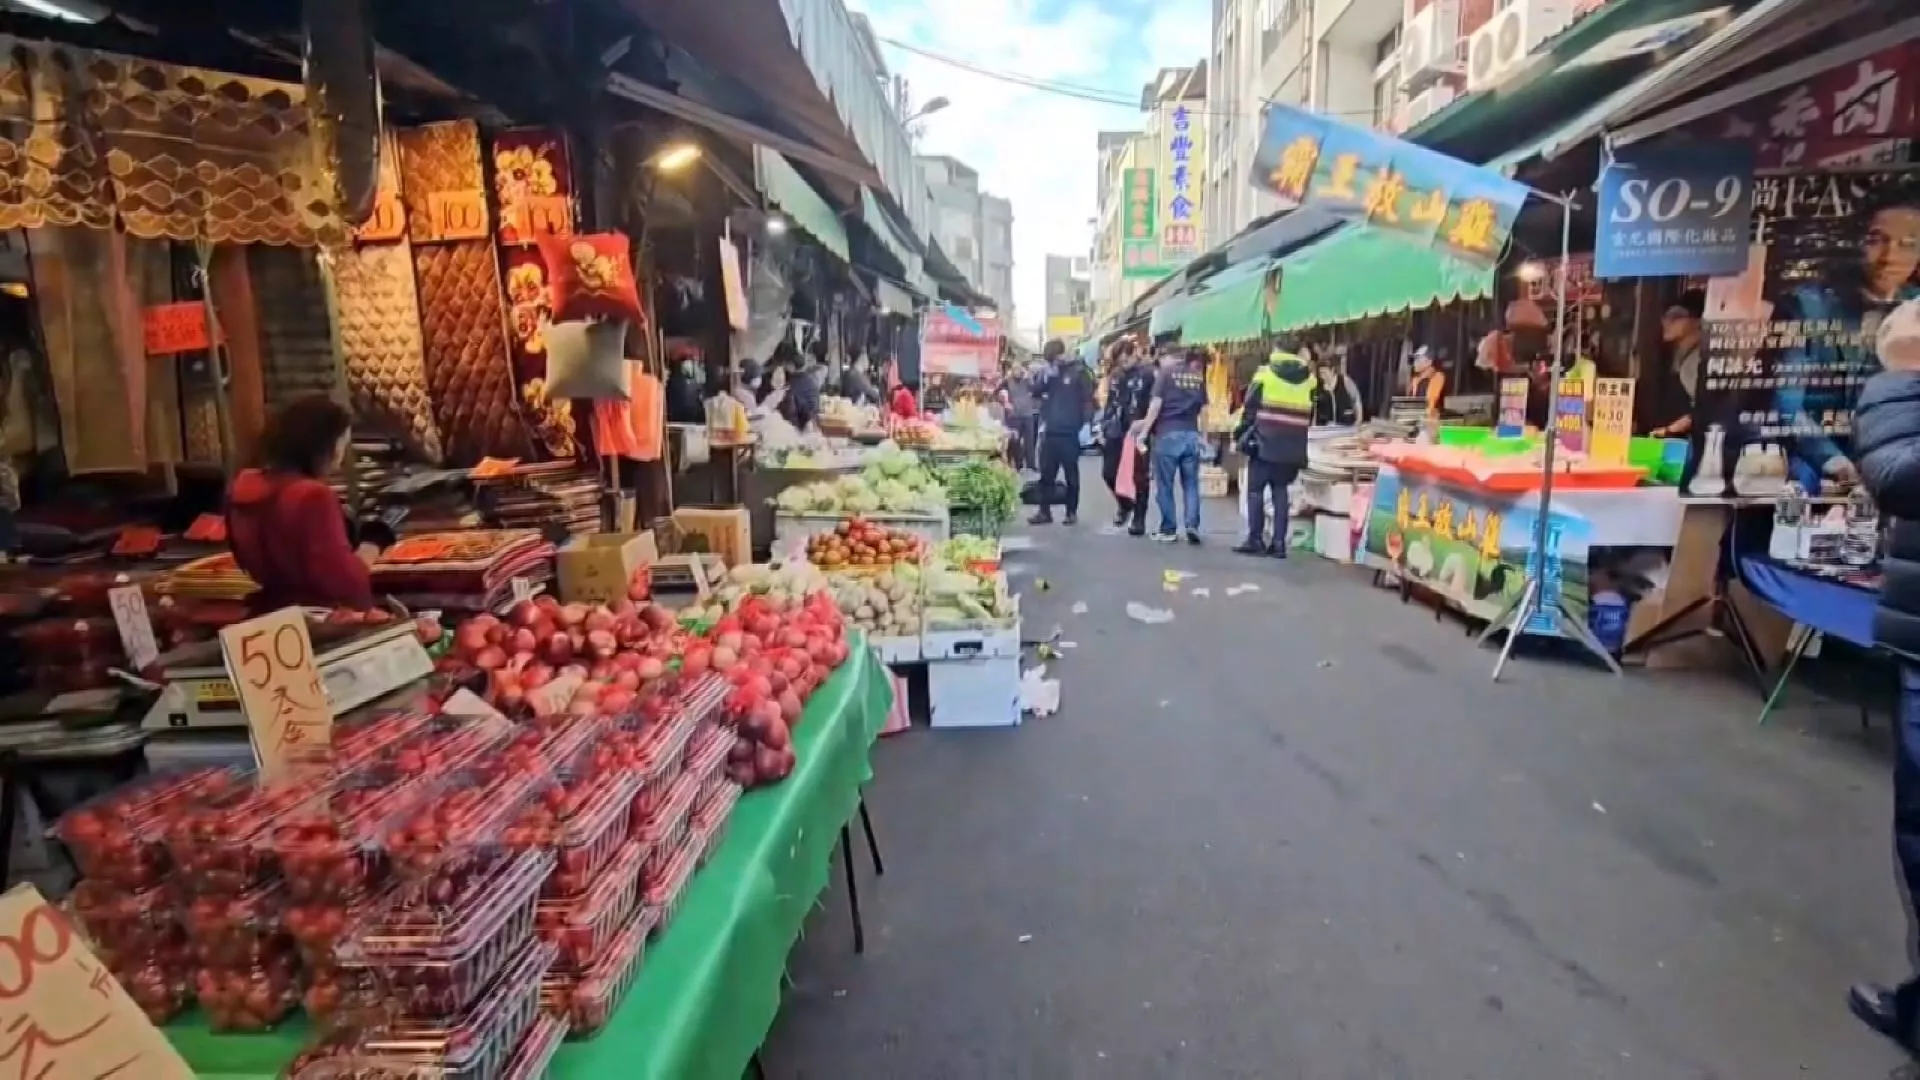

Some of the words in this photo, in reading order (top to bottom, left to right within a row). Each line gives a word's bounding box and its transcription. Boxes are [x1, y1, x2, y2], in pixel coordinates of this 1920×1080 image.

[443, 201, 482, 230] 100
[1610, 175, 1742, 223] SO-9
[241, 623, 305, 689] 50
